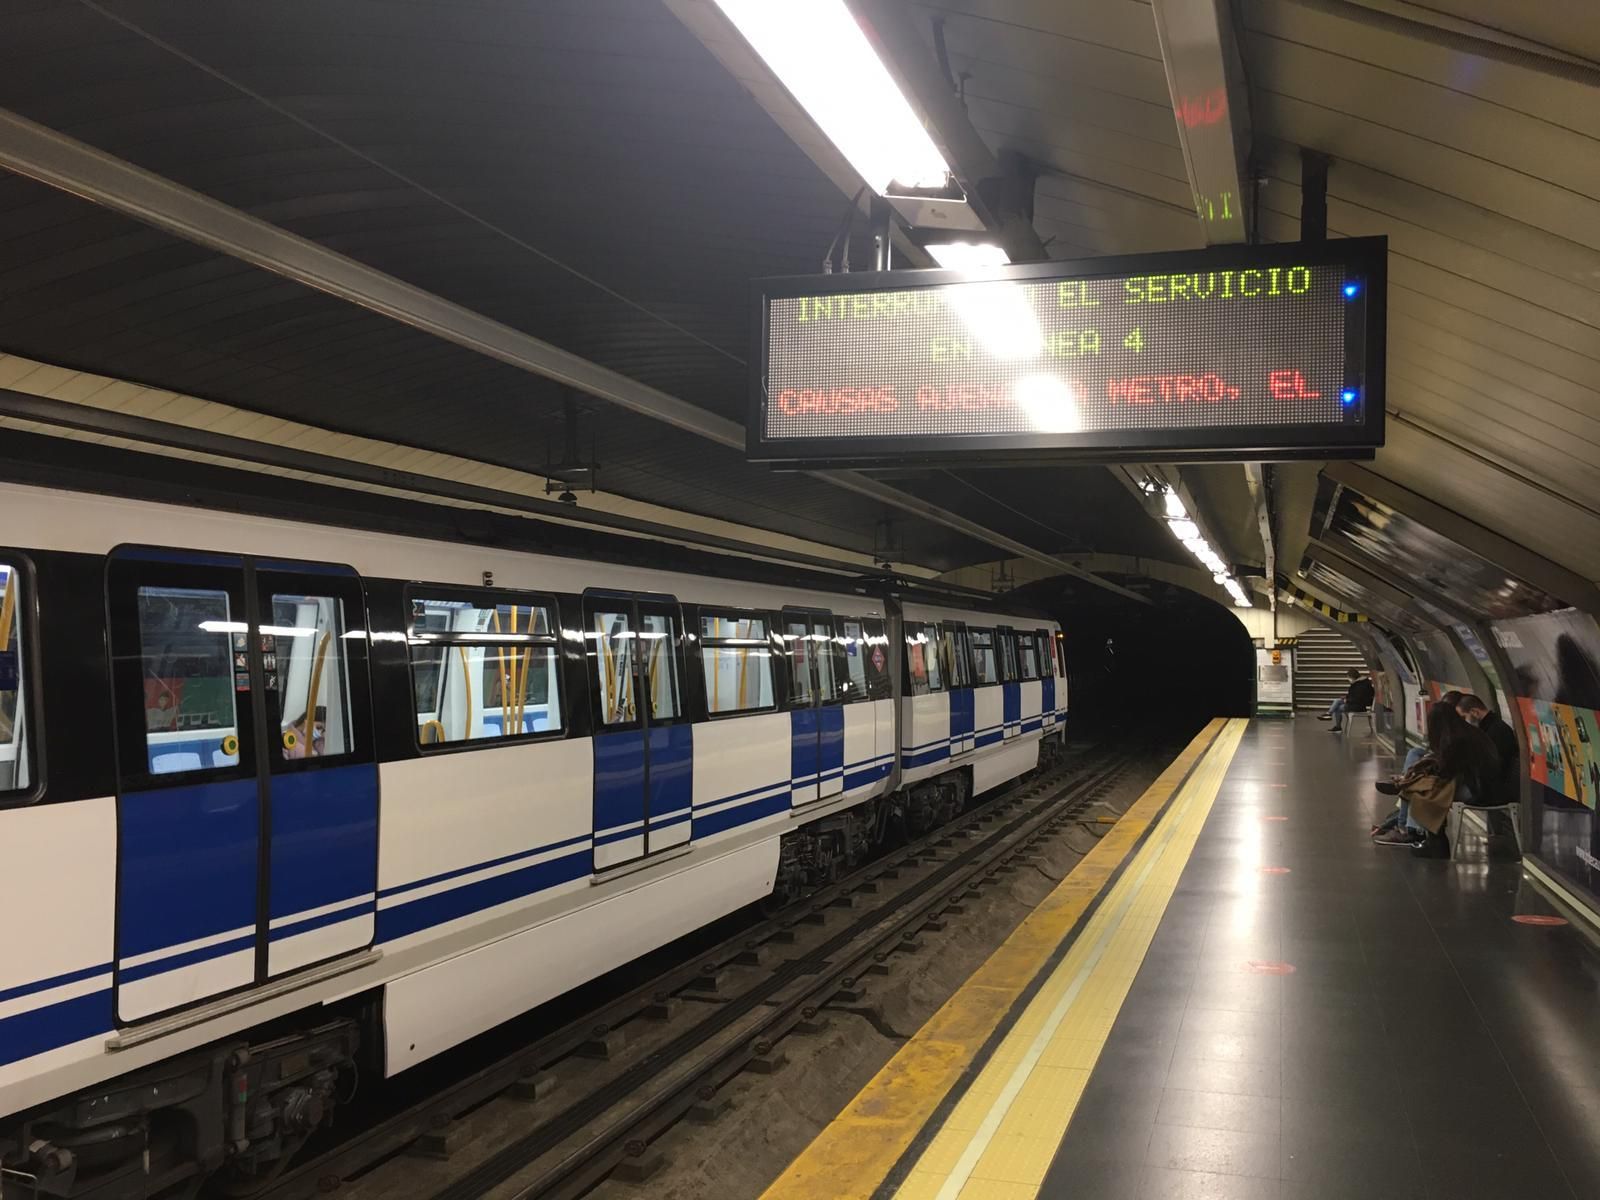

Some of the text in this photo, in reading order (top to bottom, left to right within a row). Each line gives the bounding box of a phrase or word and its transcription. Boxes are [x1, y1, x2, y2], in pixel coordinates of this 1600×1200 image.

[1057, 279, 1100, 308] EL
[1124, 265, 1312, 304] SERVICIO
[932, 336, 970, 364] EN
[1123, 327, 1144, 353] 4
[777, 384, 898, 417] CAUSAS
[1106, 371, 1241, 404] METRO,
[1268, 368, 1321, 400] EL
